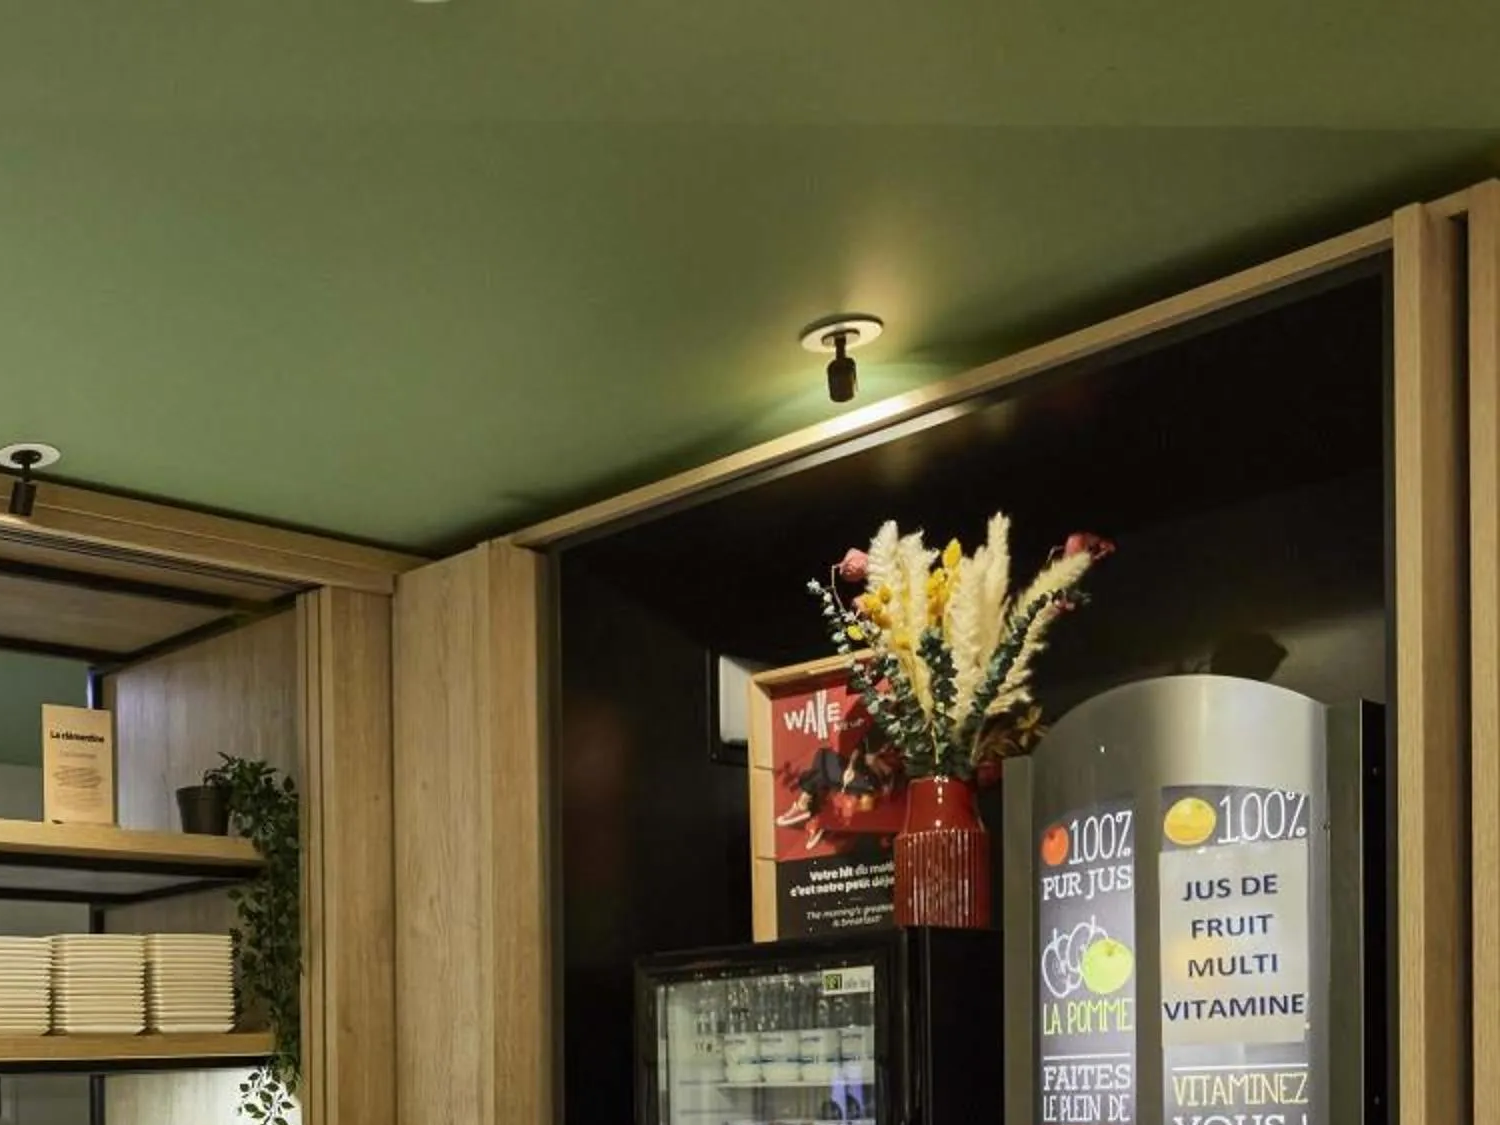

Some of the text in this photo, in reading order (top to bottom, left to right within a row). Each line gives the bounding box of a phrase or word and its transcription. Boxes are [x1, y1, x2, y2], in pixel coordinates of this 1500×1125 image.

[783, 690, 841, 740] WAKE
[1215, 790, 1307, 844] 100%
[1068, 810, 1133, 865] 100%
[1041, 865, 1132, 900] PUR JUS
[1183, 874, 1279, 901] JUS DE
[1191, 914, 1274, 939] FRUIT
[1188, 953, 1278, 978] MULTI
[1043, 997, 1134, 1035] LA POMME
[1163, 993, 1305, 1021] VITAMINE
[1043, 1063, 1132, 1091] FAITES
[1172, 1071, 1309, 1107] VITAMINEZ
[1043, 1094, 1131, 1122] LE PLEIN DE
